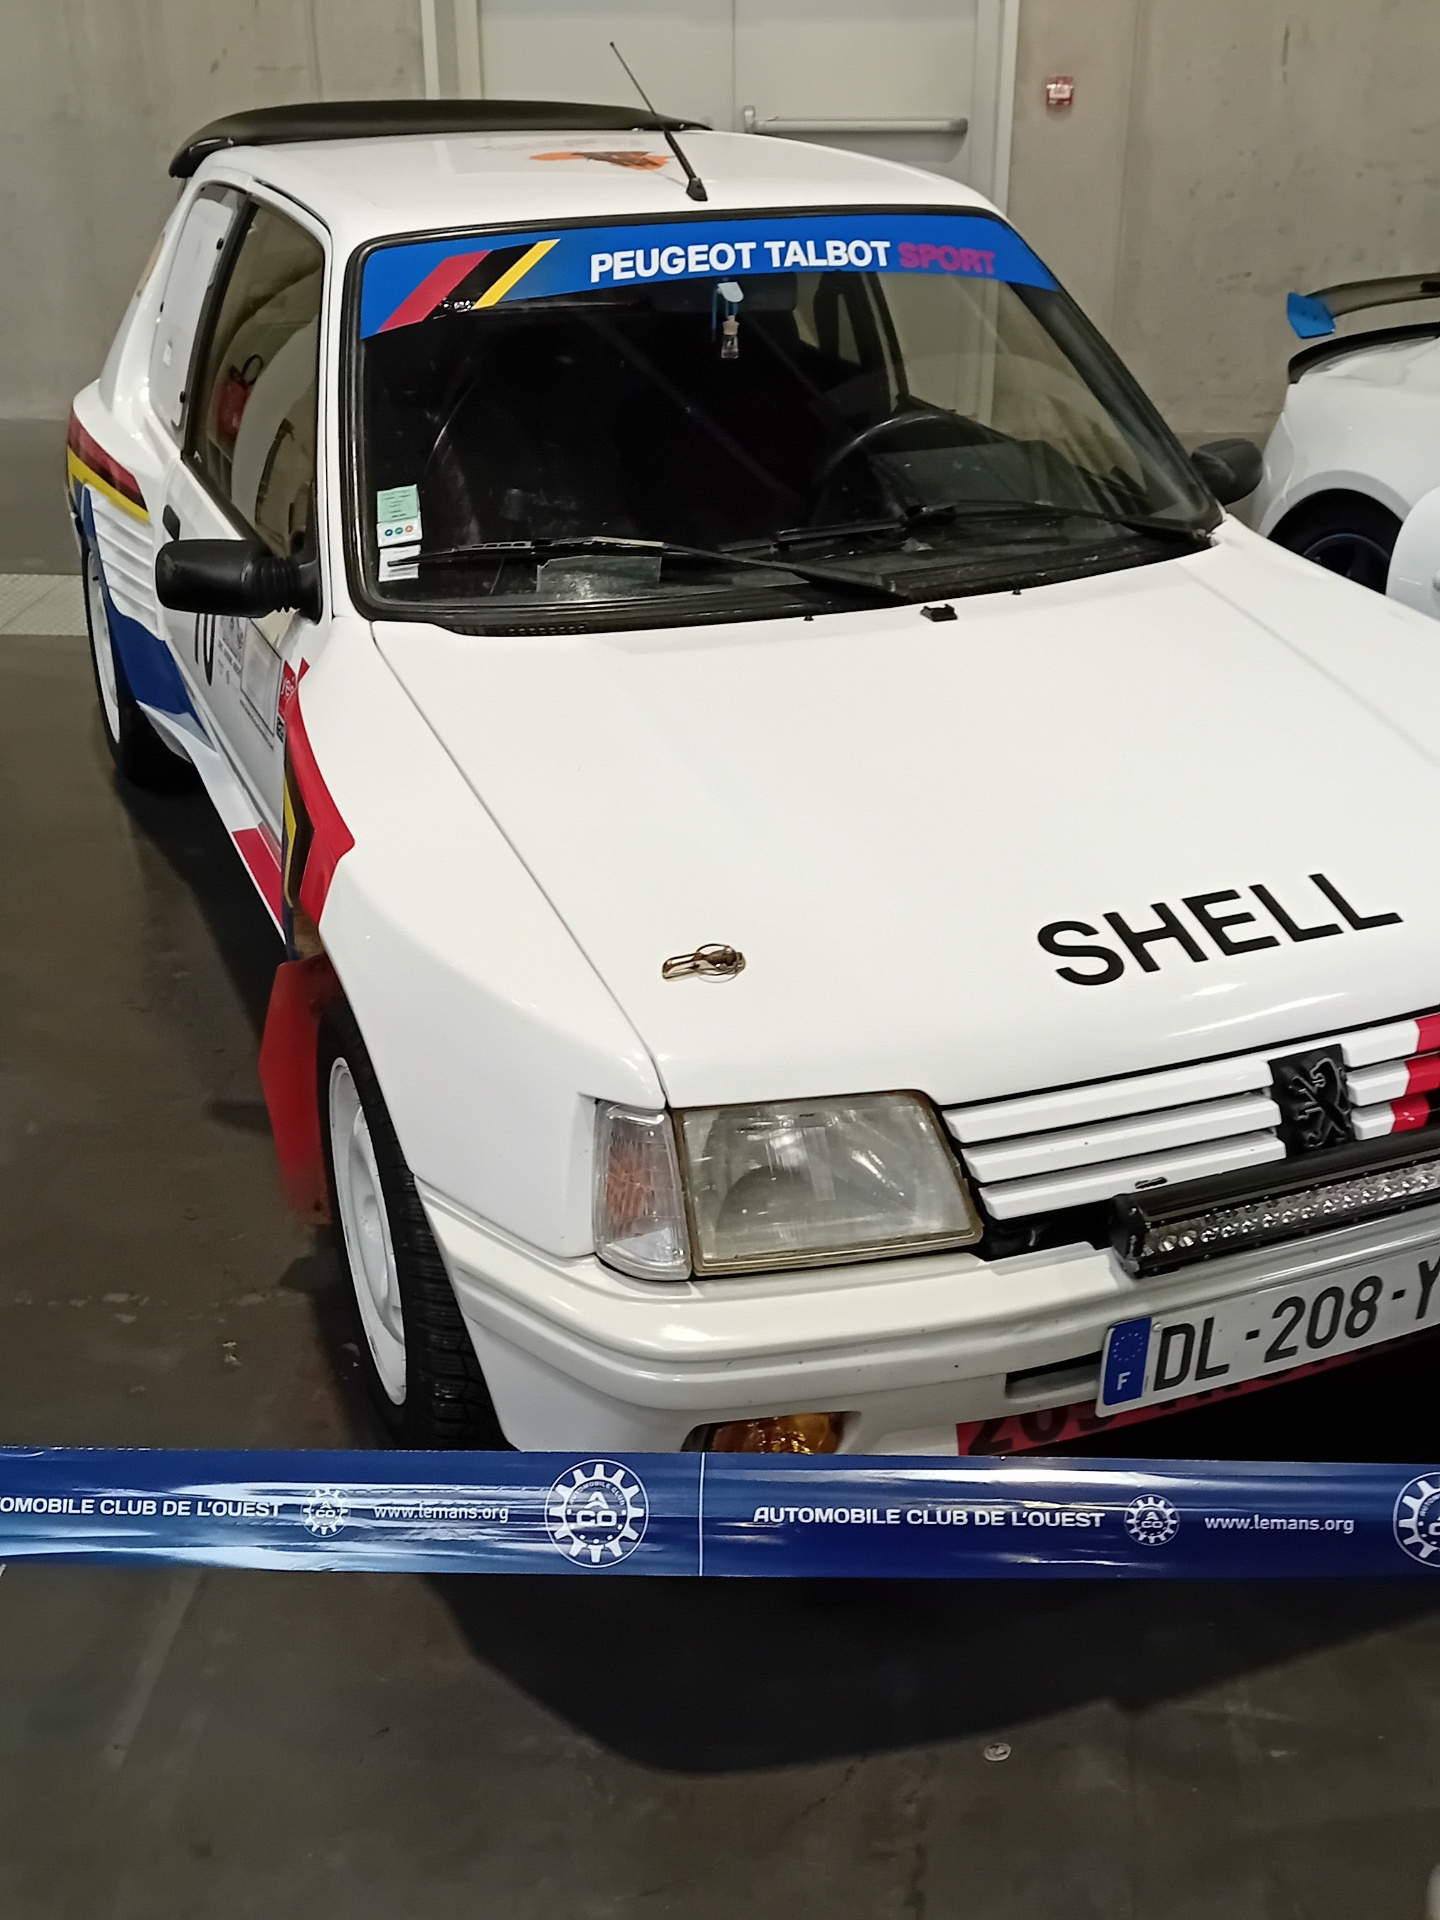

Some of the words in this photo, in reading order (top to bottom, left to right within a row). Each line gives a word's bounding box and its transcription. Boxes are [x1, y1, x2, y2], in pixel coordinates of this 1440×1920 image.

[590, 241, 757, 284] PEUGEOT
[763, 240, 891, 268] TALBOT
[897, 242, 997, 275] SPORT
[1036, 873, 1405, 986] SHELL
[1116, 1371, 1132, 1392] F
[0, 1496, 95, 1515] OMOBILE
[99, 1498, 158, 1516] CLUB
[161, 1499, 191, 1516] DE
[195, 1499, 284, 1518] L'OUEST
[372, 1502, 510, 1523] www.lemans.org
[752, 1505, 902, 1525] AUTOMOBILE
[905, 1508, 969, 1526] CLUB
[973, 1510, 1007, 1527] DE
[1010, 1511, 1106, 1529] L'OUEST
[1203, 1513, 1356, 1534] www.lemans.org
